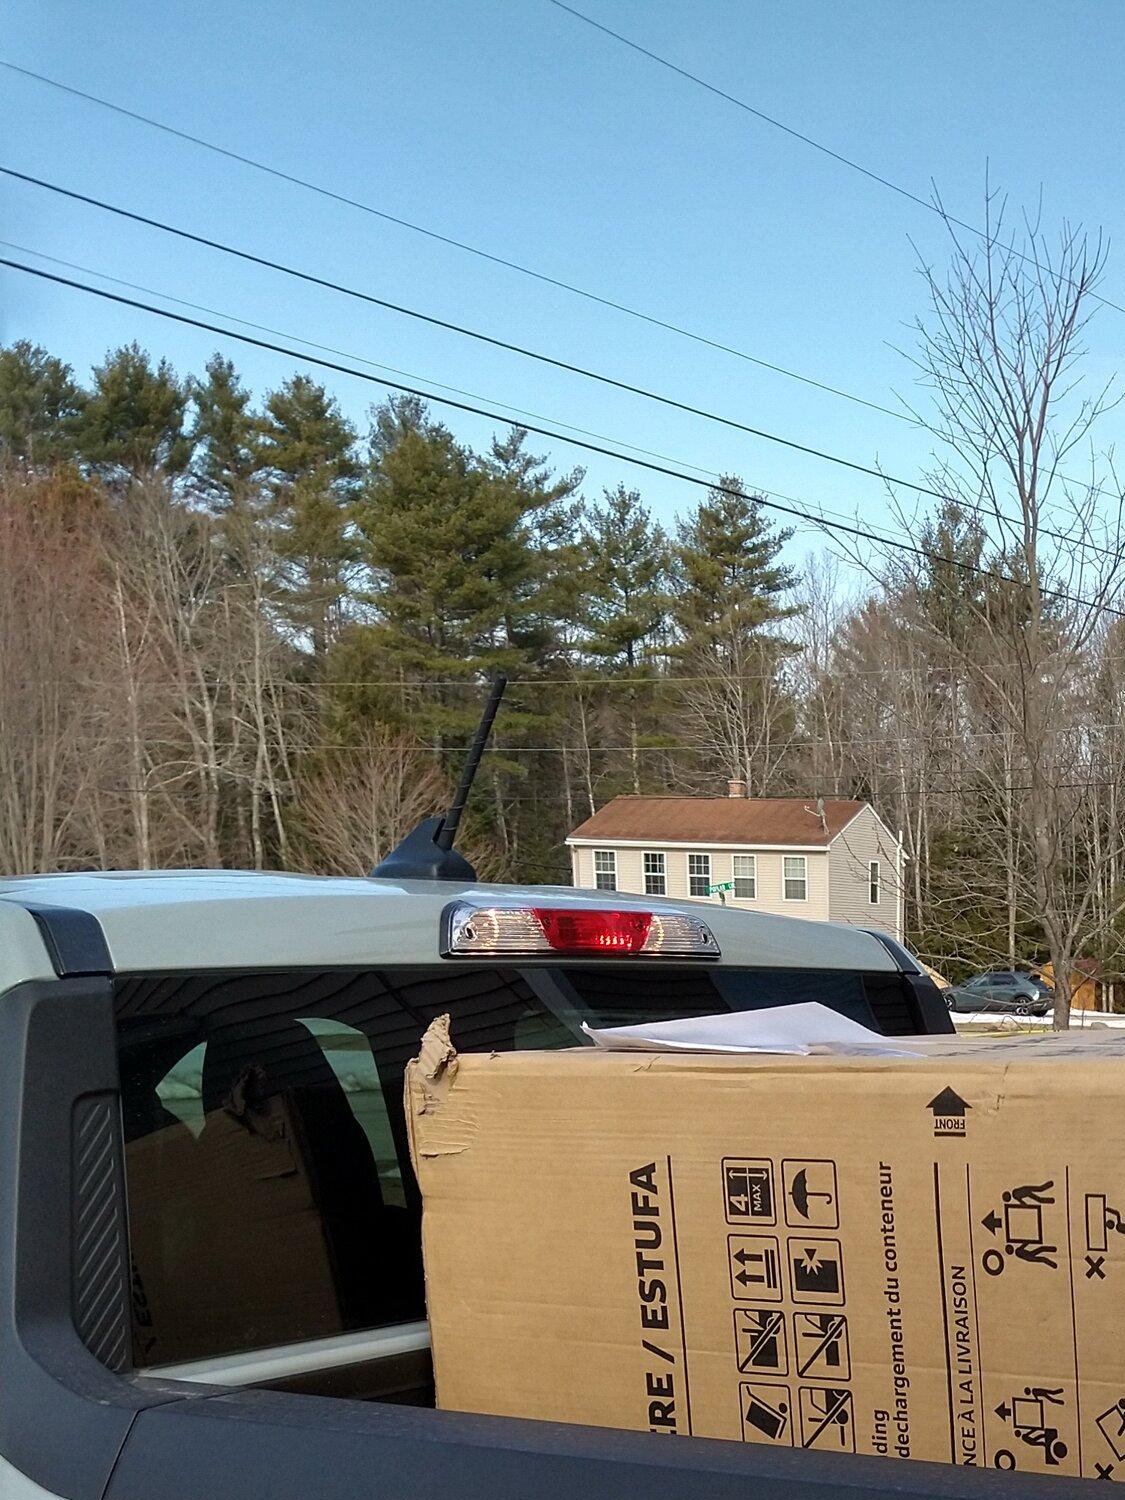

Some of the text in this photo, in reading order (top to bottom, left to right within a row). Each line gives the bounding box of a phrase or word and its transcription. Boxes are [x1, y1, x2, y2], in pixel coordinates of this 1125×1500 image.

[934, 1118, 966, 1130] FRONT
[730, 1193, 748, 1212] 4
[752, 1183, 763, 1212] MAX
[629, 1162, 677, 1434] RE / ESTUFA
[878, 1161, 911, 1458] dechargement du conteneur
[951, 1265, 973, 1376] LIVRAISON
[959, 1380, 974, 1402] LA
[957, 1409, 975, 1423] À
